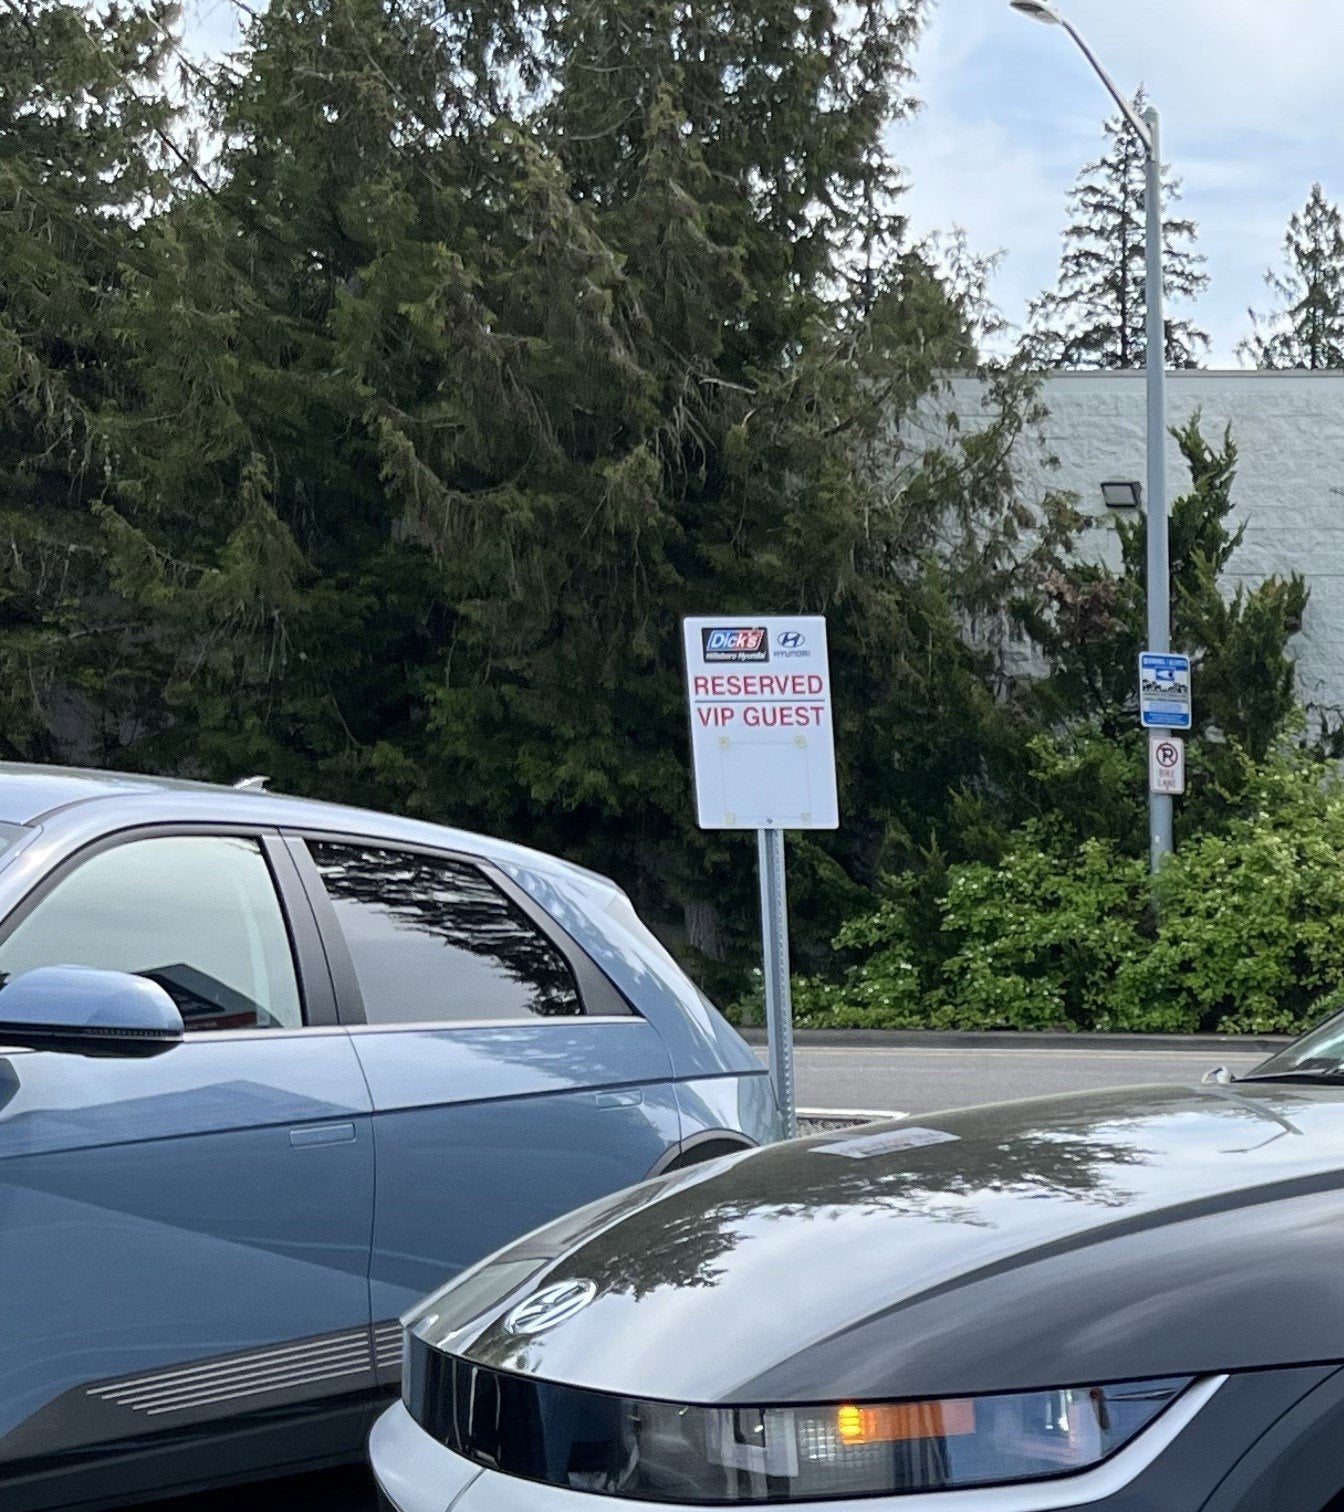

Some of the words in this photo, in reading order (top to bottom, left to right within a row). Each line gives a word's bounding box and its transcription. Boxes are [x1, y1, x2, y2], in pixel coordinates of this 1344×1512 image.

[694, 675, 824, 696] RESERVED
[697, 707, 735, 727] VIP
[743, 706, 825, 727] GUEST
